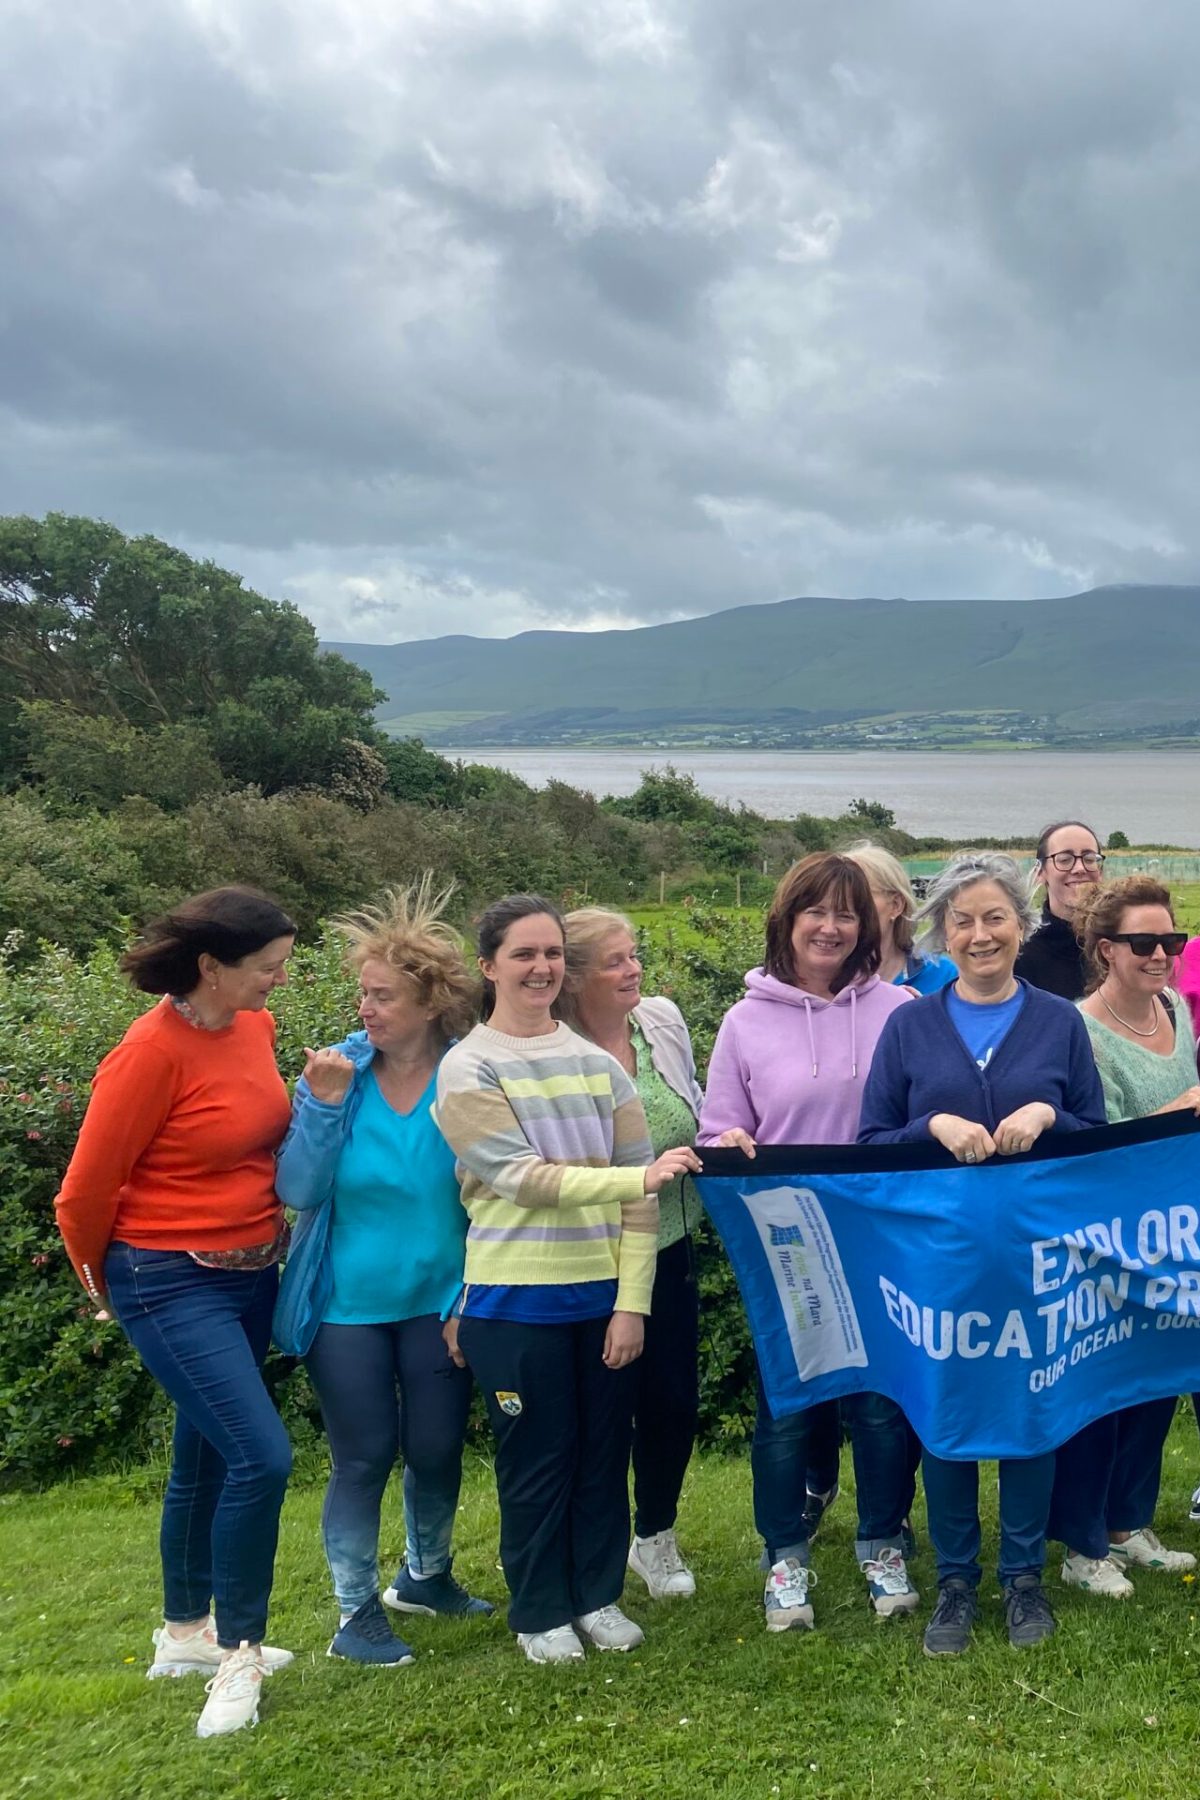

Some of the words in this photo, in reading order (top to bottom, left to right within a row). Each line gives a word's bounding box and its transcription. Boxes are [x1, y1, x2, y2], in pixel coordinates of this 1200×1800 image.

[778, 1250, 796, 1288] Marine
[807, 1294, 822, 1327] Mara
[879, 1271, 1131, 1361] EDUCATION
[1029, 1354, 1067, 1394] OUR
[1070, 1316, 1133, 1366] OCEAN
